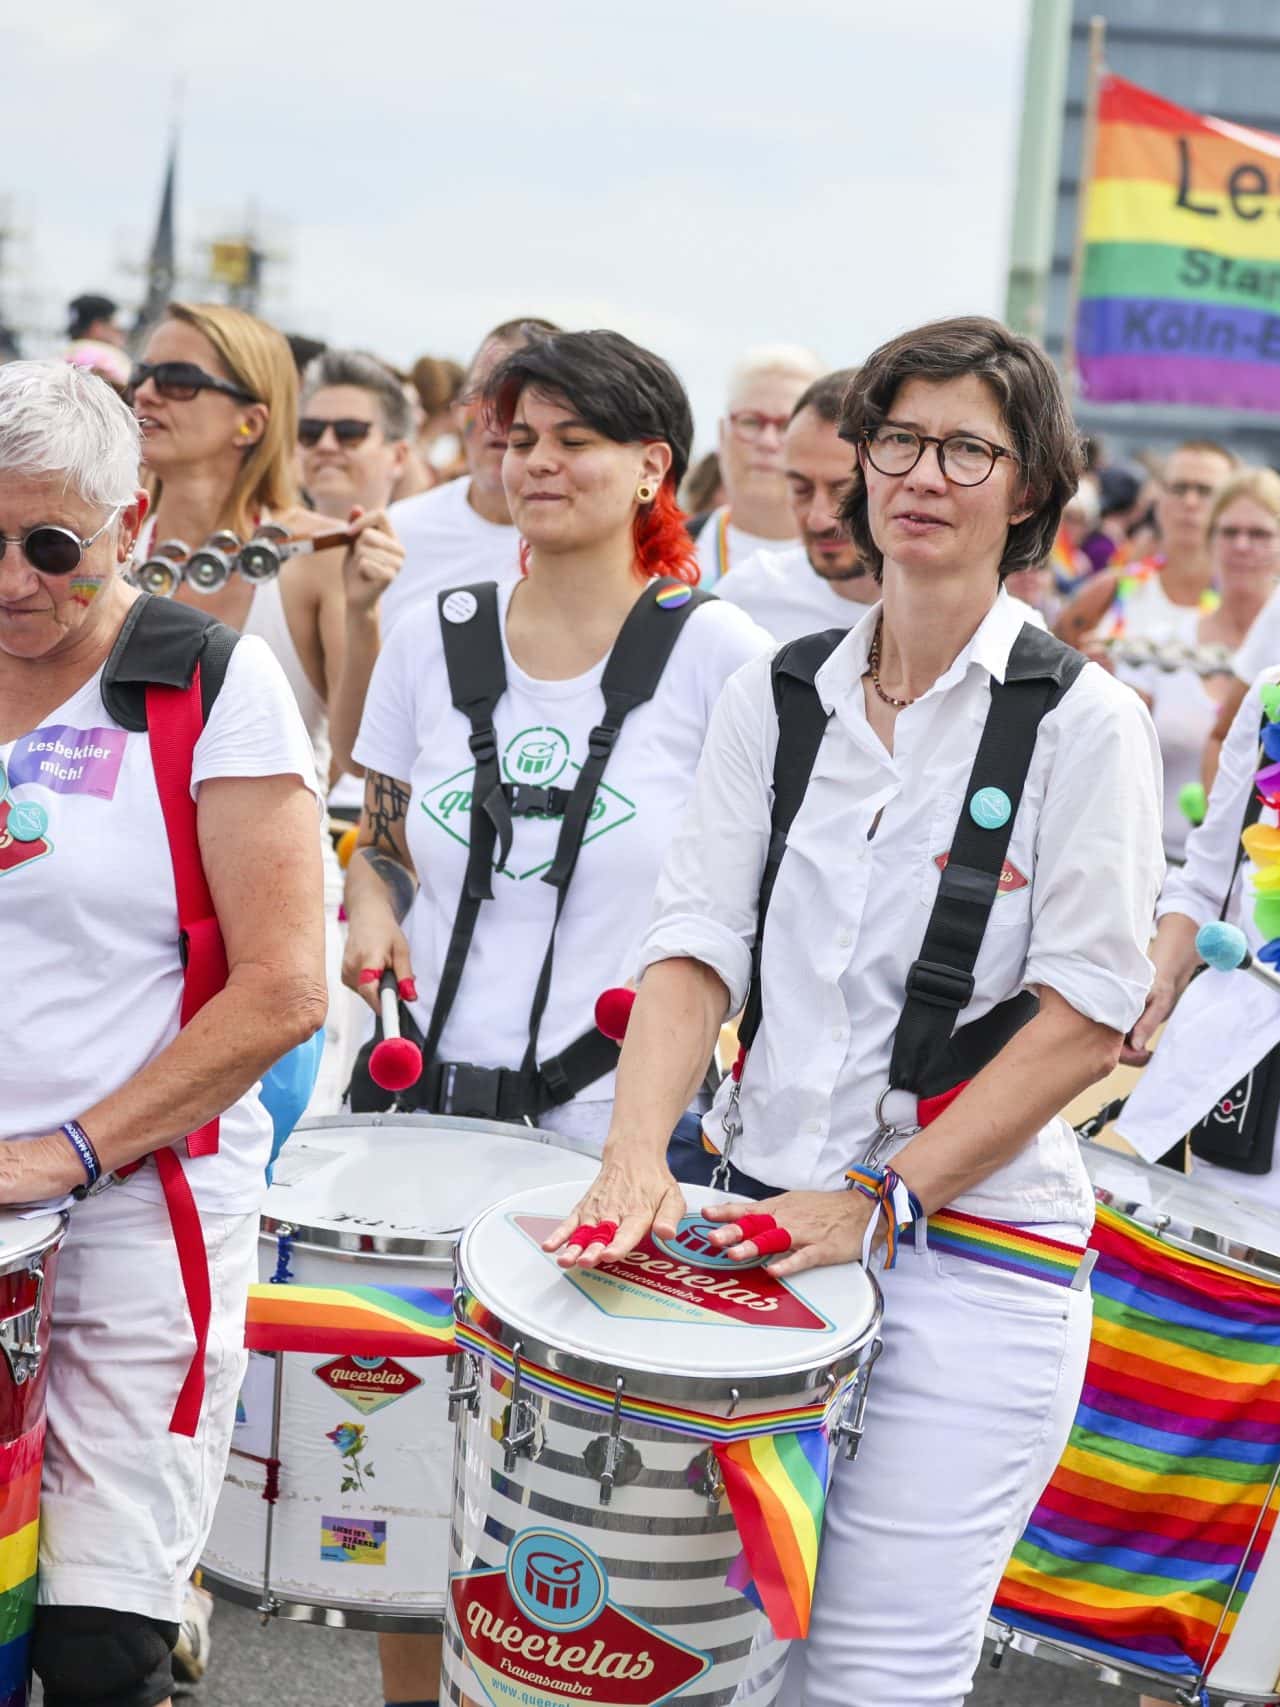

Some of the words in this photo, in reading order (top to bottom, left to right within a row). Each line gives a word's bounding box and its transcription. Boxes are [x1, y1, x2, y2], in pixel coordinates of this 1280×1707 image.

[27, 740, 112, 760] Lesbektier
[39, 760, 84, 781] mich!
[602, 1263, 705, 1303] Frauensamba
[621, 1251, 780, 1313] eerelas
[329, 1368, 406, 1385] queerelas
[466, 1600, 655, 1680] queerelas
[500, 1657, 593, 1697] Frauensamba
